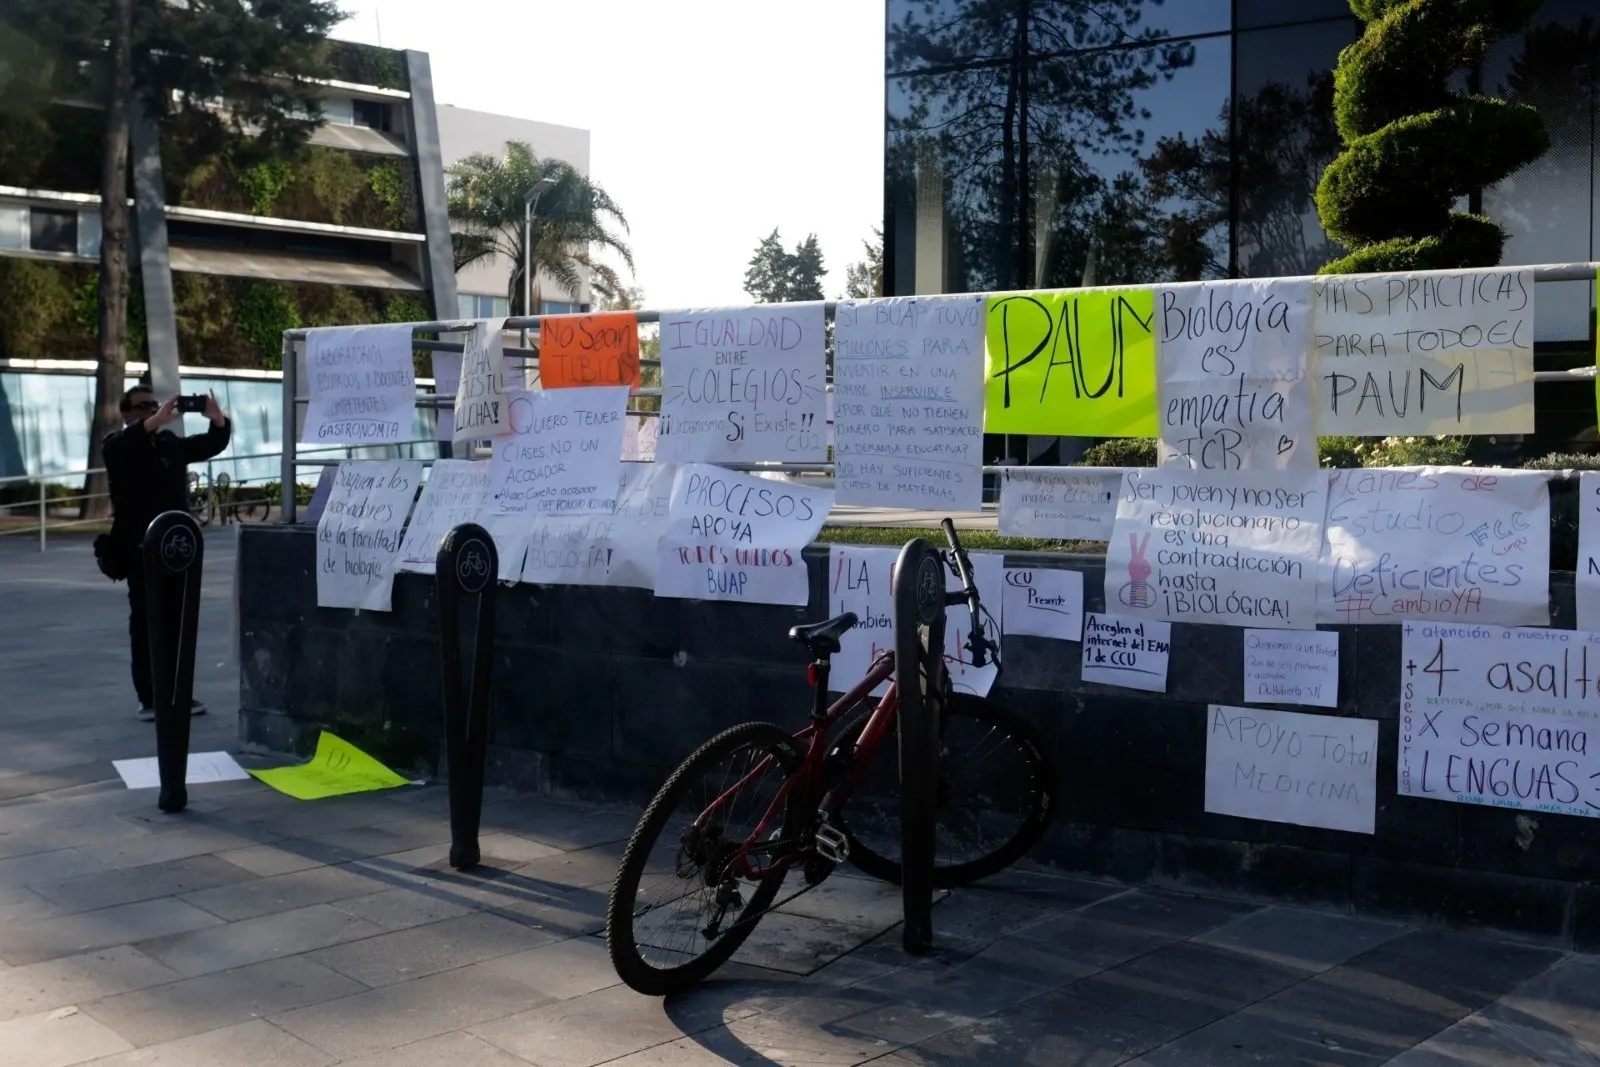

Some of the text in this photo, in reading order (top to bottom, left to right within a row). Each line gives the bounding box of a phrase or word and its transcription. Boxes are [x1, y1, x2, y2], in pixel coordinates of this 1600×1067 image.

[1386, 271, 1528, 316] PRACTICAS
[840, 304, 979, 328] SI BUAP TUVO
[543, 316, 631, 351] No Sean
[669, 316, 802, 350] IGUALDAD
[1315, 320, 1529, 356] PARA TODO EL
[715, 350, 749, 366] ENTRE
[836, 338, 970, 356] MILLONES PARA
[1201, 345, 1234, 376] es
[836, 366, 957, 380] INVERTIR EN UNA
[688, 368, 802, 410] COLEGIOS
[836, 384, 952, 398] TORRE INSERVIBLE
[1324, 363, 1464, 424] PAUM
[456, 401, 499, 432] LUCHA!
[509, 398, 620, 434] QUIERO TENER
[902, 407, 920, 418] NO
[924, 408, 969, 420] TIENEN
[318, 422, 399, 439] GASTRONOMIA
[836, 424, 880, 436] DINERO
[888, 425, 916, 436] PARA
[550, 440, 572, 454] NO
[580, 439, 598, 450] UN
[786, 434, 821, 452] CU2
[837, 444, 850, 453] LA
[854, 444, 900, 454] DEMANDA
[376, 476, 385, 489] a
[388, 467, 408, 490] los
[505, 463, 566, 484] ACOSADOR
[838, 462, 962, 482] NO HAY SUFICIENTES
[1327, 470, 1498, 496] Planes de
[685, 474, 813, 520] PROCESOS
[842, 482, 956, 500] CUPOS DE MATERIAS
[1126, 472, 1162, 504] Ser
[1168, 484, 1223, 507] joven
[1226, 488, 1238, 510] y
[1243, 487, 1272, 507] no
[326, 498, 393, 522] acosadores
[1150, 509, 1300, 532] revolucionario
[1329, 498, 1464, 538] Estudio
[320, 518, 333, 542] de
[337, 522, 347, 545] la
[690, 514, 753, 543] APOYA
[1164, 529, 1228, 548] es una
[324, 548, 336, 574] de
[678, 545, 793, 567] TODOS UNIDOS
[1158, 548, 1302, 580] contradicción
[708, 568, 748, 596] BUAP
[1005, 572, 1032, 585] CCU
[1158, 570, 1216, 592] hasta
[1332, 552, 1524, 598] Deficientes
[1028, 588, 1066, 606] Presente
[1162, 590, 1292, 624] ¡BIOLÓGICA!
[1086, 616, 1144, 637] Arreglen el
[1422, 626, 1490, 640] atención
[1502, 630, 1511, 640] a
[1518, 628, 1570, 642] nuestra
[1088, 634, 1170, 654] internet del EMA
[1085, 648, 1136, 666] 1 de CCU
[1423, 638, 1460, 696] 4
[1213, 708, 1302, 758] APOYO
[1460, 715, 1586, 756] Semana
[1234, 761, 1360, 804] MEDICINA
[1420, 750, 1579, 804] LENGUAS
